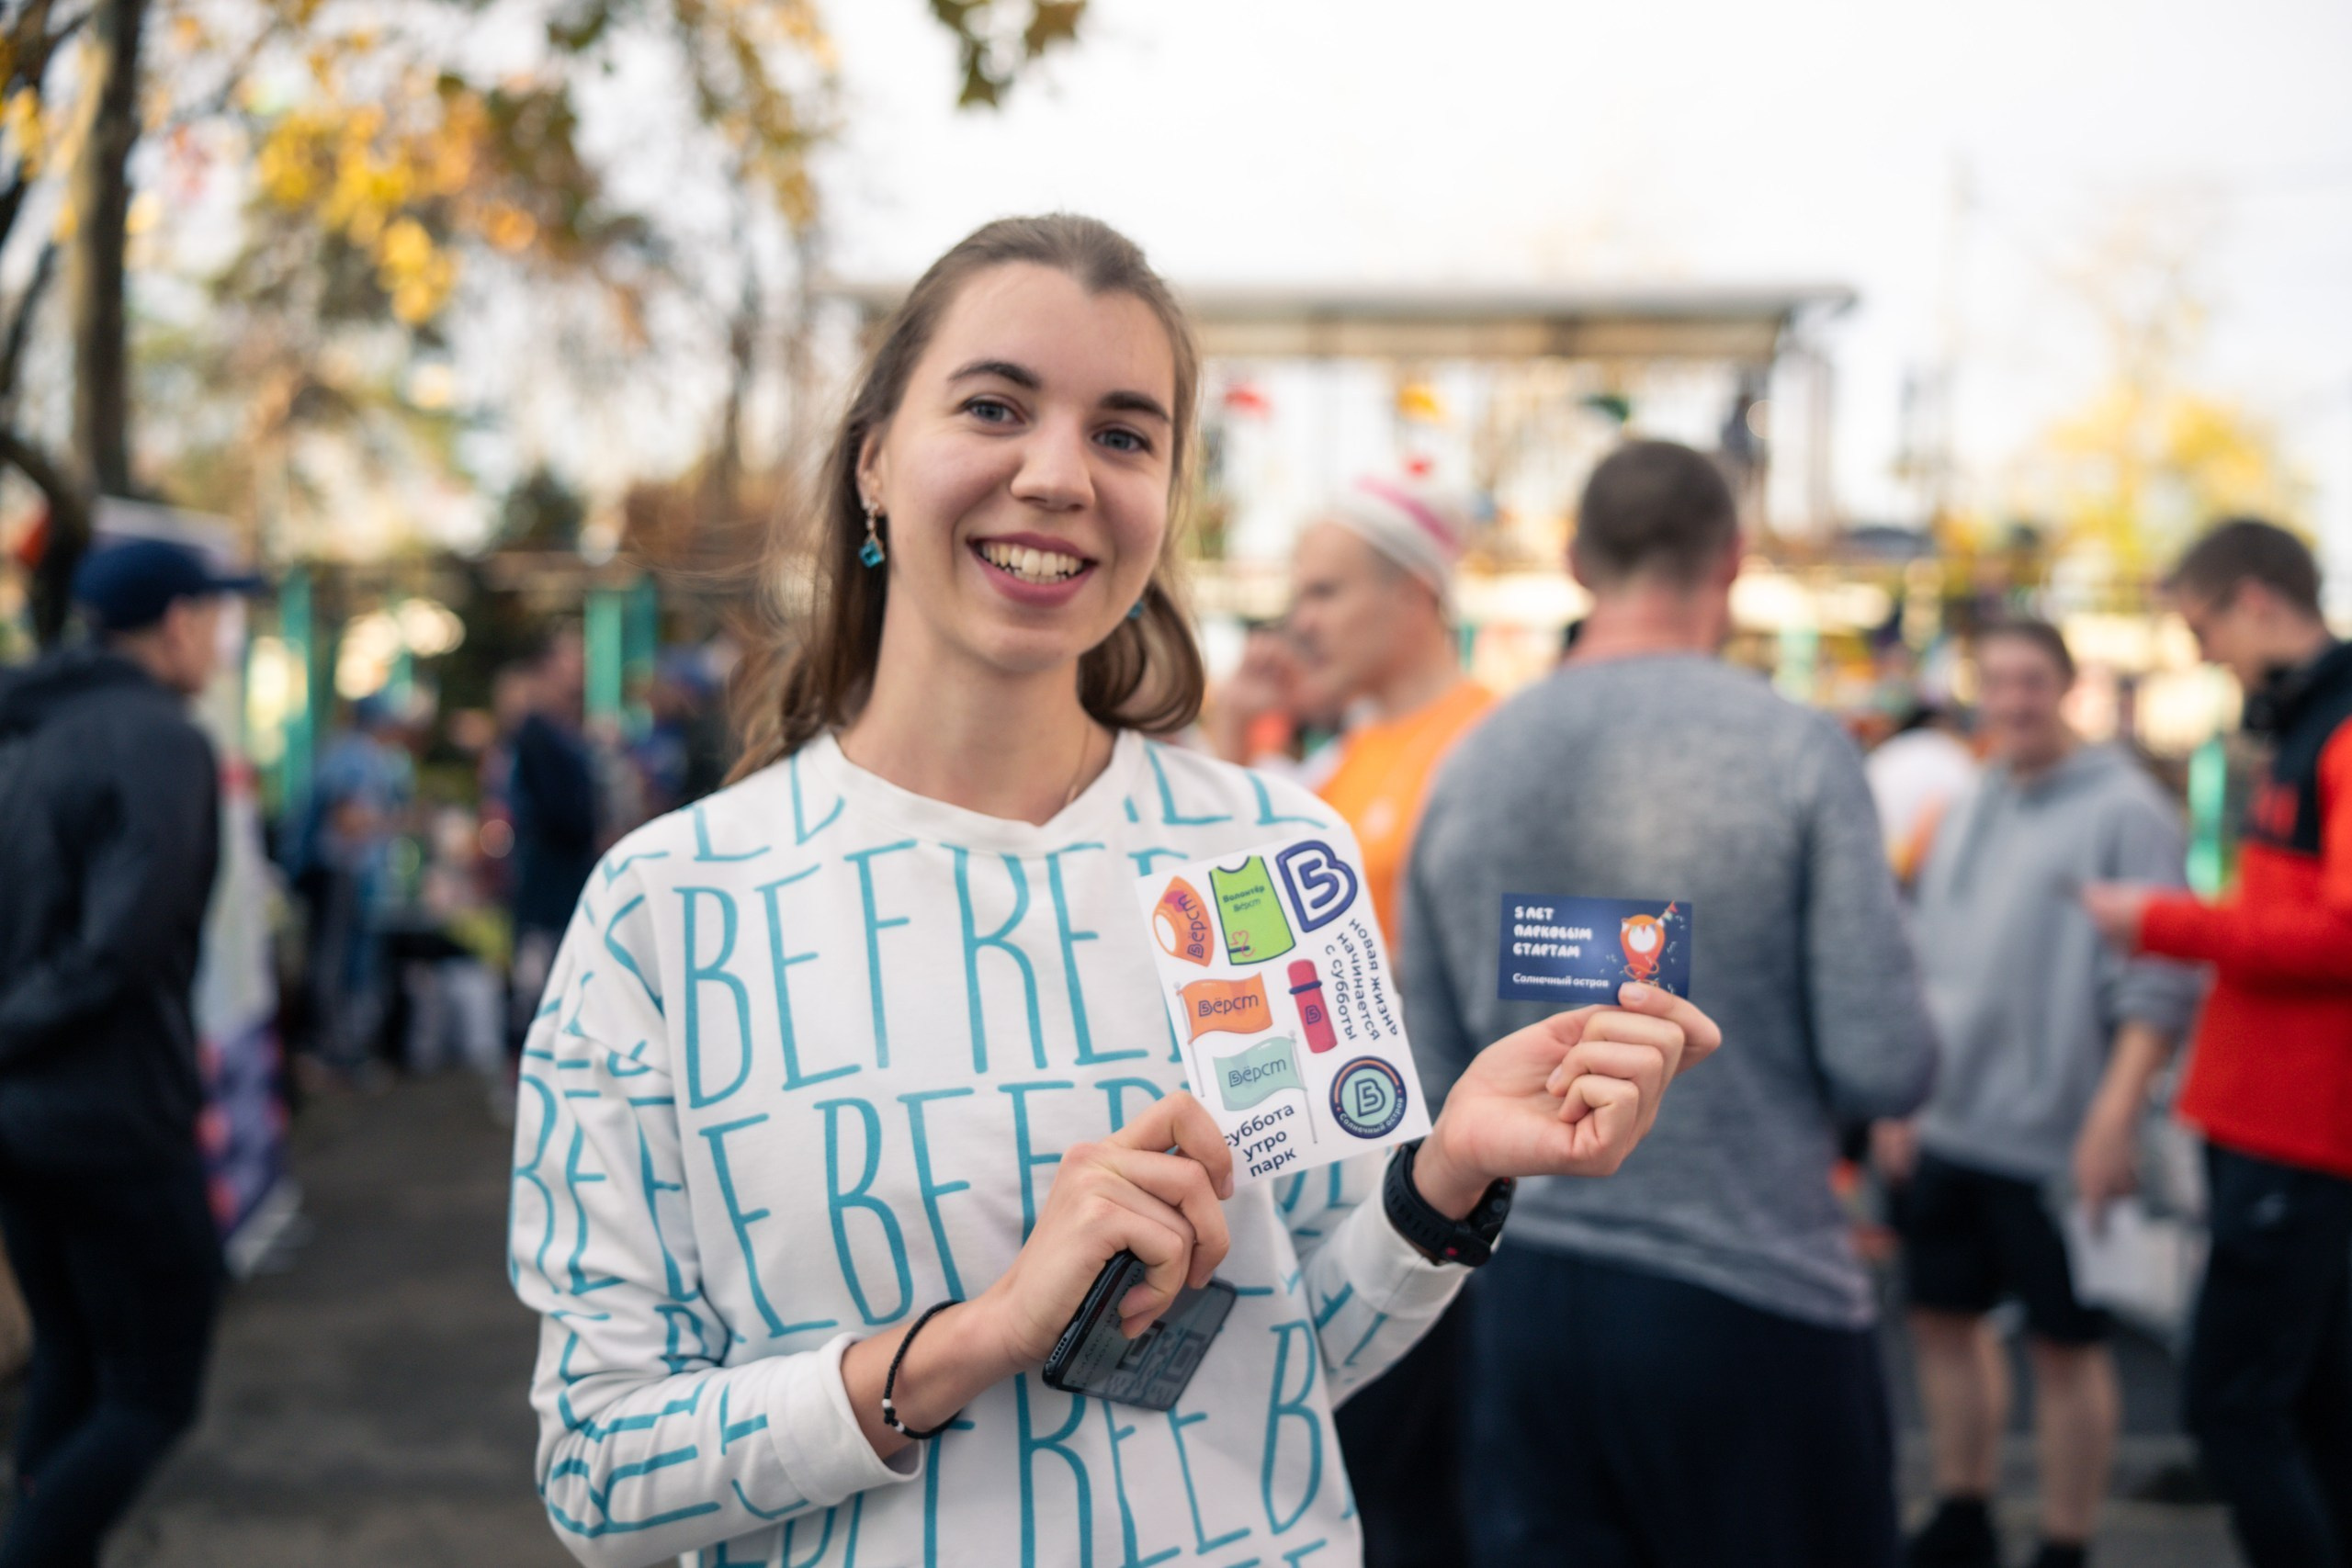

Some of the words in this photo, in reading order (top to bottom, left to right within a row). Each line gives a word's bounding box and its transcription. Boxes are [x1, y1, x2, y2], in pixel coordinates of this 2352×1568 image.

[1330, 959, 1358, 1040] субботы
[1337, 932, 1381, 1041] начинается
[1349, 919, 1378, 970] новая
[1371, 977, 1398, 1036] жизнь
[1512, 973, 1572, 987] Солнечный
[1573, 978, 1609, 988] остров
[1242, 1131, 1287, 1162] утро
[1250, 1148, 1296, 1177] парк
